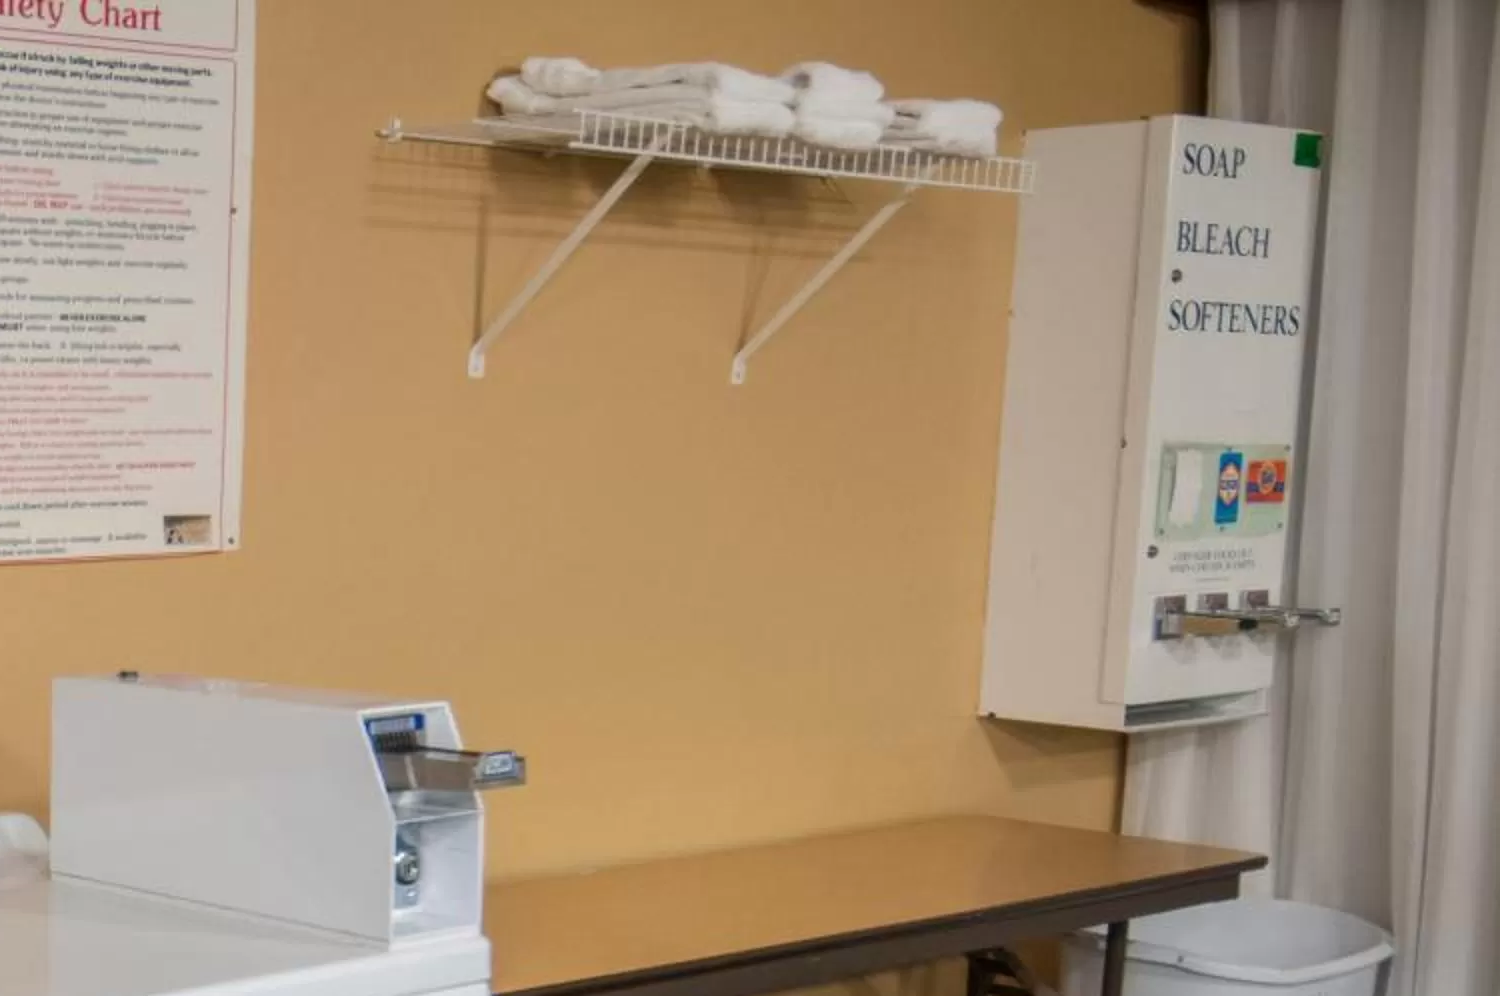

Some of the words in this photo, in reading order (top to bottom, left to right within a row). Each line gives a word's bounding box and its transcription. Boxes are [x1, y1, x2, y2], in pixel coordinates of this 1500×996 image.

[80, 0, 163, 30] Chart
[1182, 142, 1246, 179] SOAP
[1176, 220, 1271, 259] BLEACH
[1167, 298, 1301, 337] SOFTENERS
